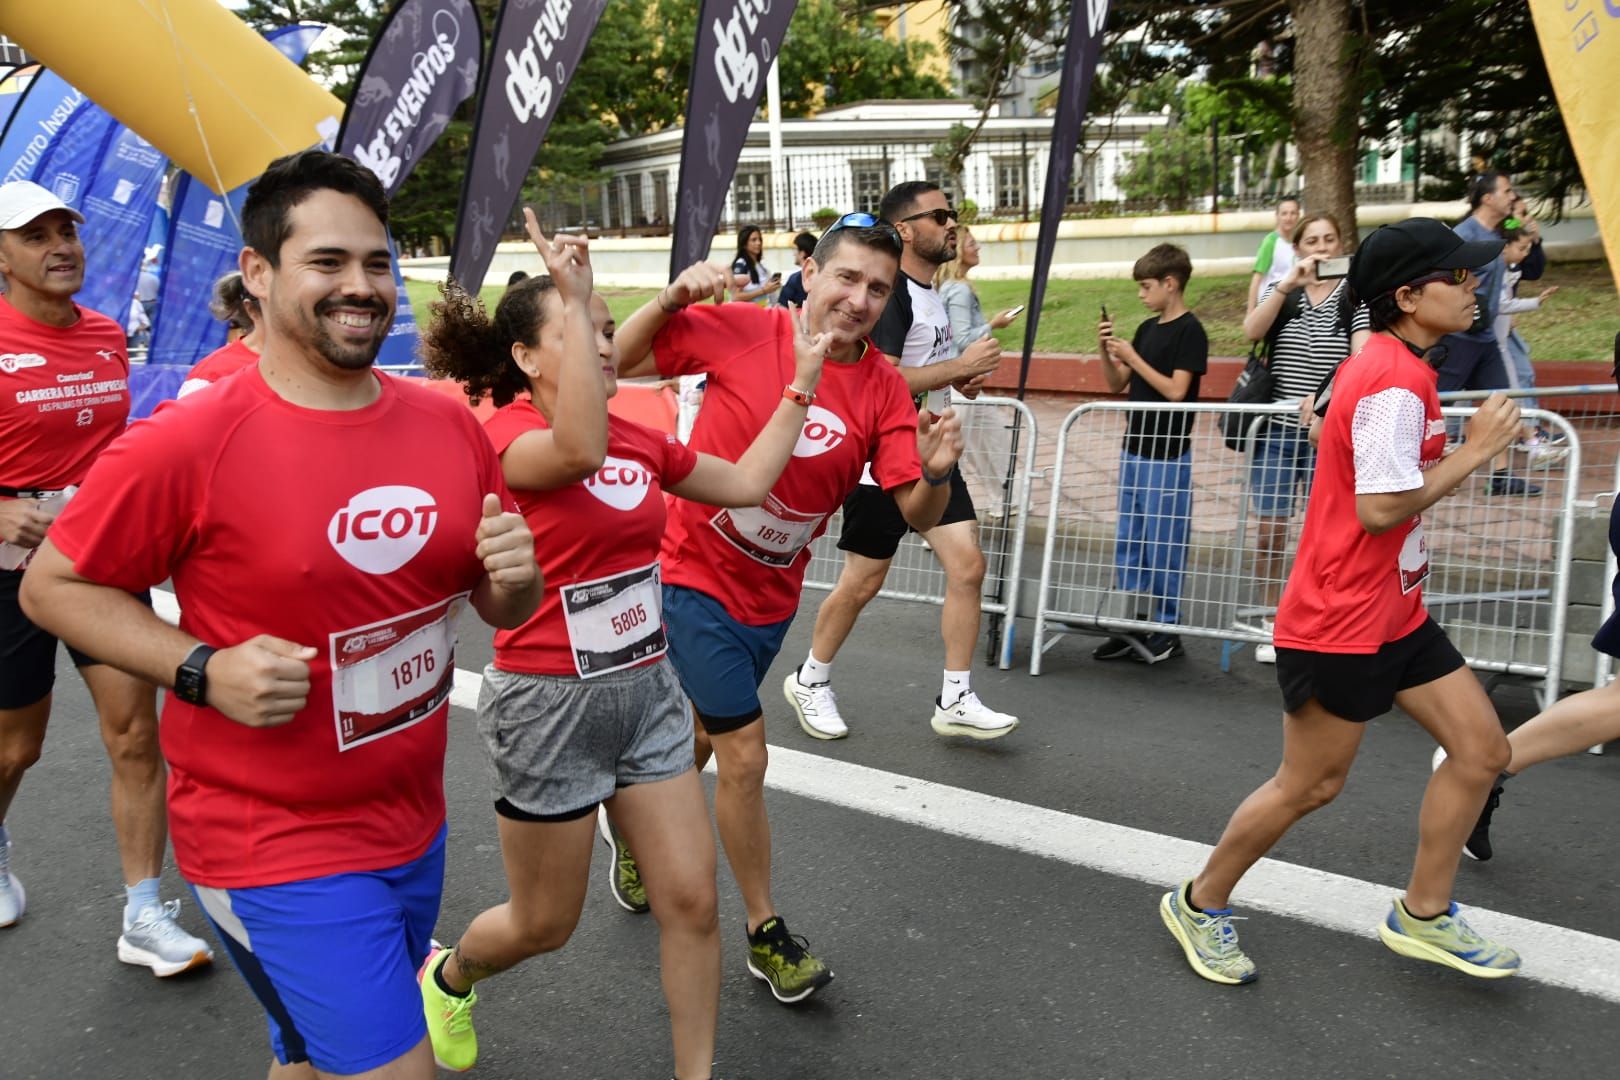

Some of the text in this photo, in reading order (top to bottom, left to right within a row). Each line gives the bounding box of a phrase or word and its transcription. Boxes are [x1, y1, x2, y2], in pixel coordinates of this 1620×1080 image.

[384, 33, 456, 144] EVENTOS
[16, 387, 64, 404] CARRERA
[63, 385, 77, 398] DE
[77, 383, 93, 397] LAS
[803, 417, 845, 447] OT
[336, 505, 440, 544] ICOT
[756, 524, 791, 545] 1875
[611, 602, 647, 636] 5805
[391, 648, 436, 691] 1876
